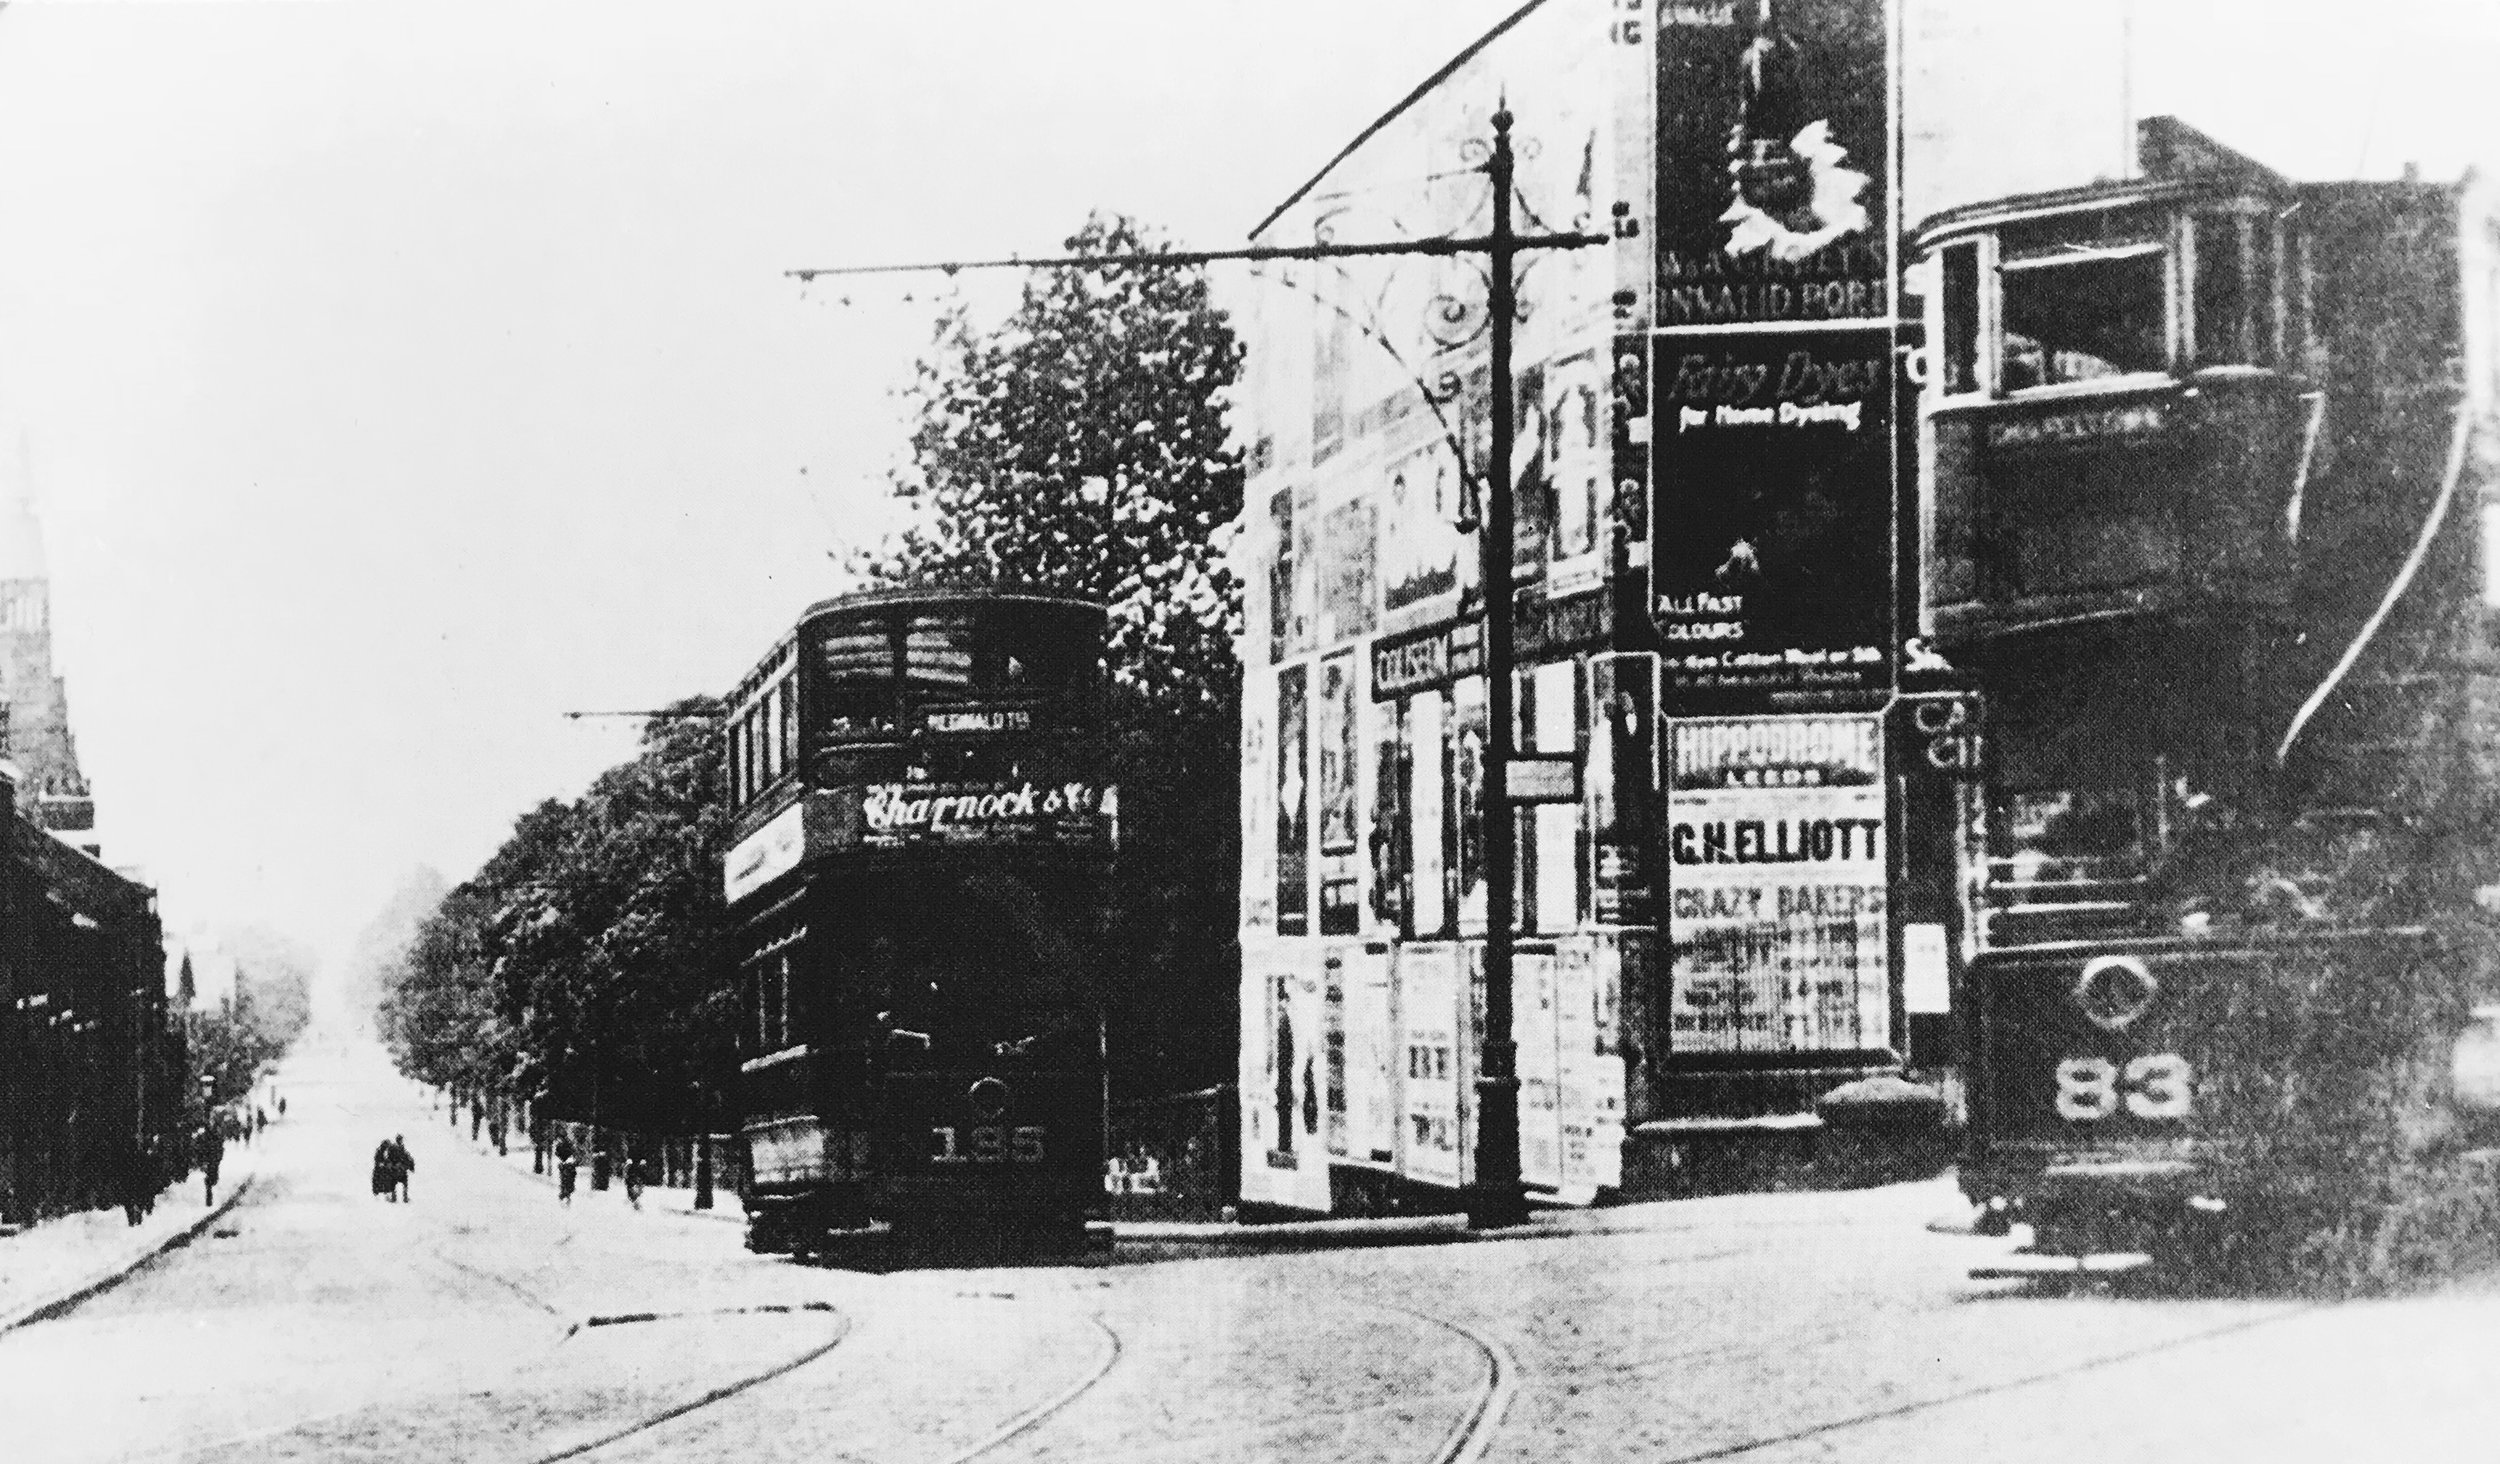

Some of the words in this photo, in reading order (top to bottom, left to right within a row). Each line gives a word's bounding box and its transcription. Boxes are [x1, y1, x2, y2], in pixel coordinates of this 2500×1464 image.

[1675, 723, 1875, 776] HIPPODROME
[863, 782, 1040, 831] Charnock
[1675, 887, 1762, 919] CRAZY
[2056, 1054, 2191, 1120] 83
